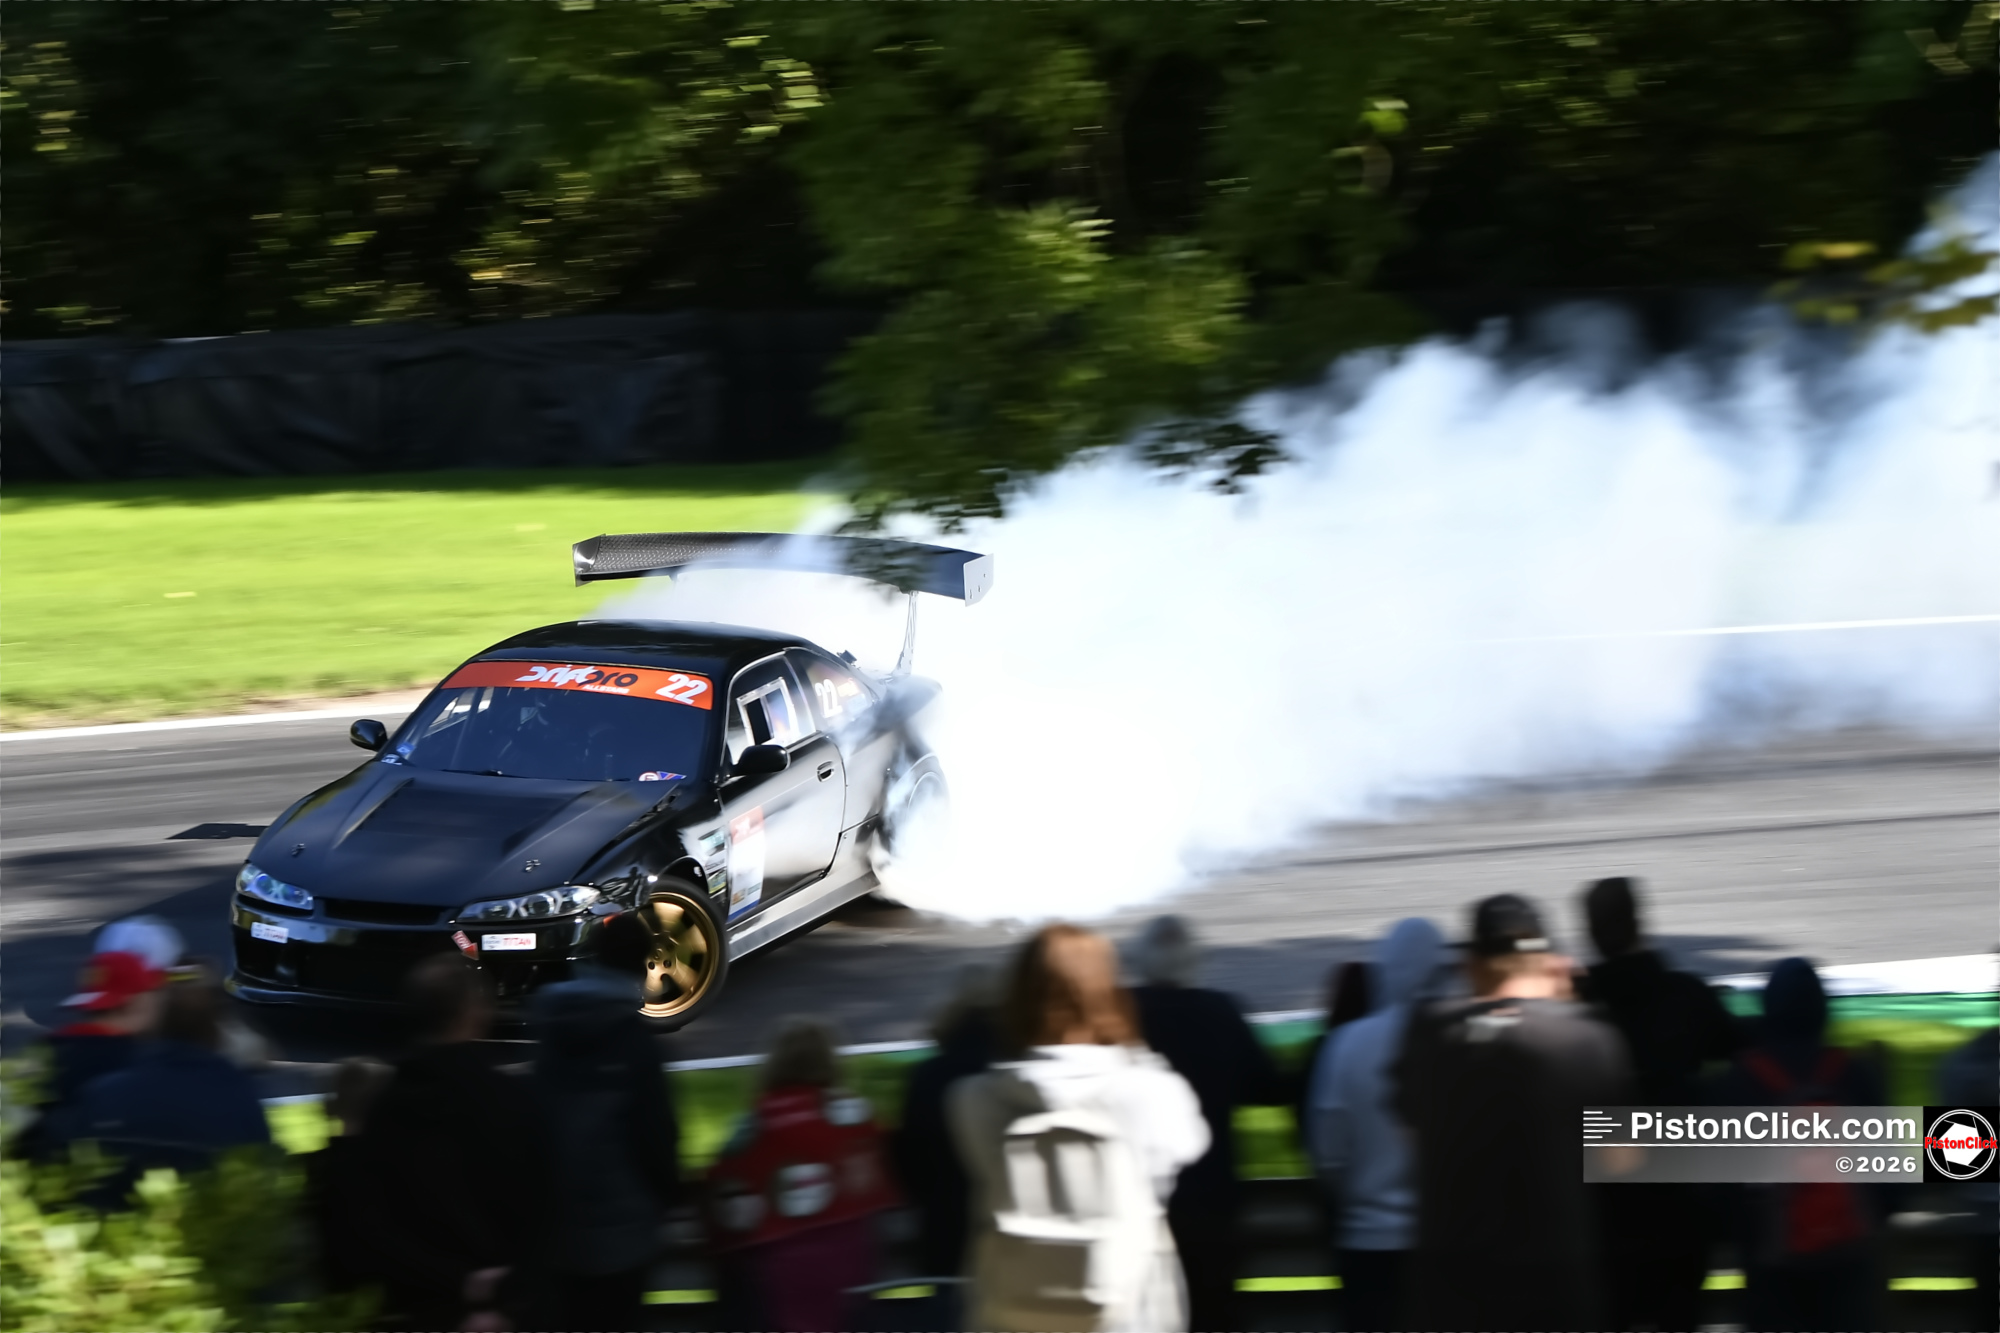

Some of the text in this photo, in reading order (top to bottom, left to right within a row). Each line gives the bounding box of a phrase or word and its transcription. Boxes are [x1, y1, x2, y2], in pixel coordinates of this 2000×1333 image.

[655, 674, 708, 705] 22
[814, 678, 843, 719] 22
[502, 937, 532, 947] TITAN
